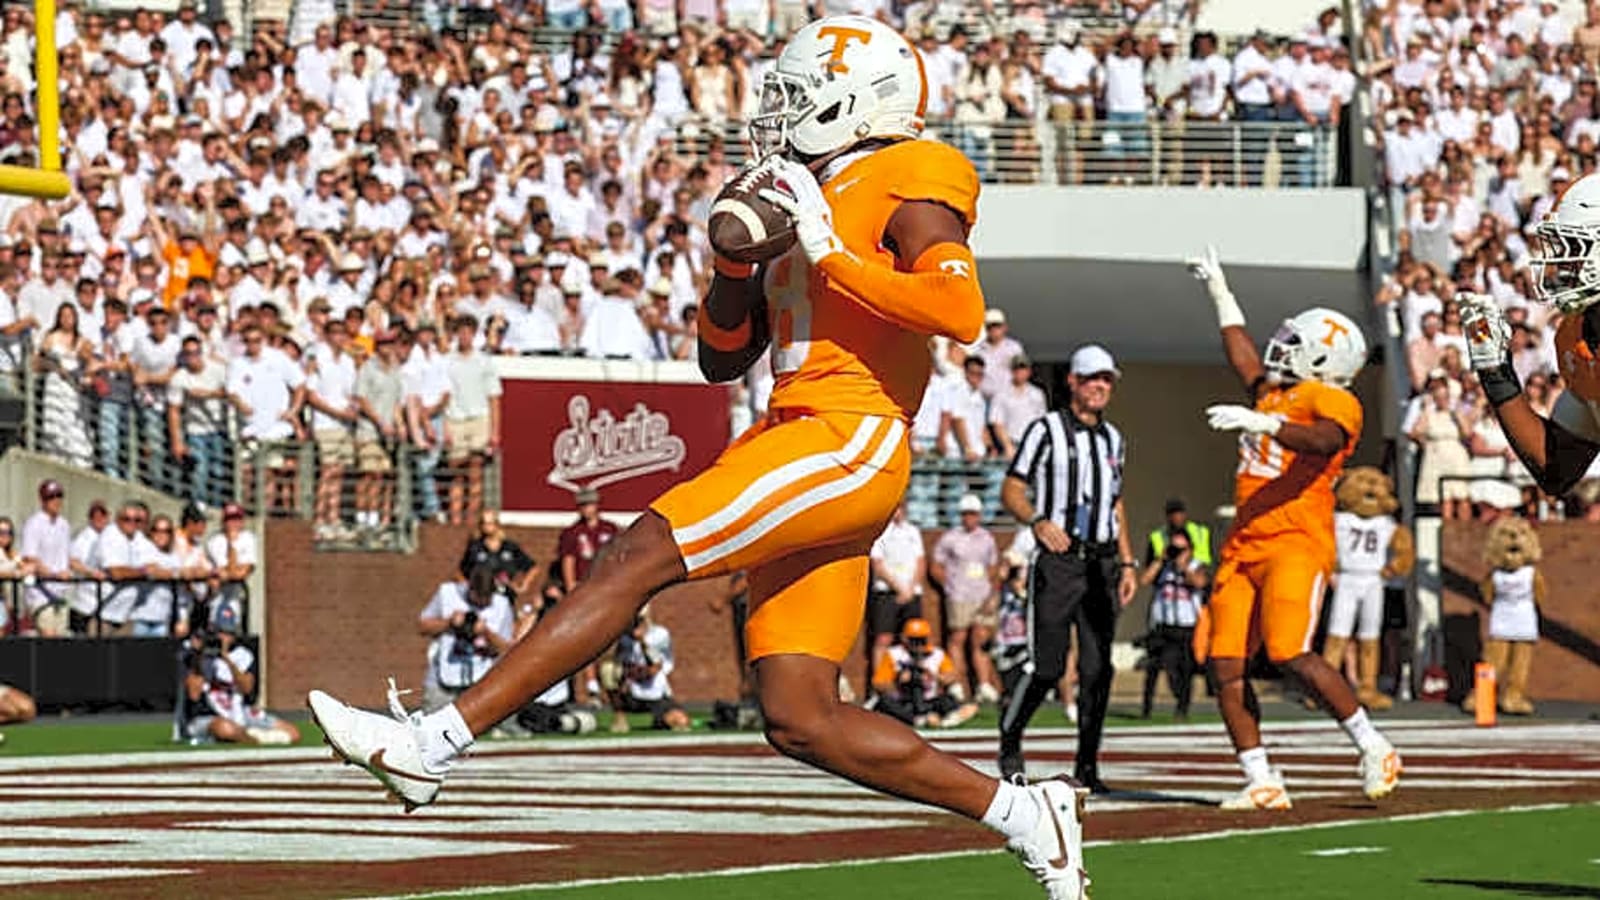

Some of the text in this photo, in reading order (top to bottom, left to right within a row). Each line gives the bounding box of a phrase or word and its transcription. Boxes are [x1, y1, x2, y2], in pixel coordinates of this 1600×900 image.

[817, 26, 872, 74] T
[764, 254, 812, 374] 8
[1322, 318, 1349, 346] T
[549, 395, 685, 488] State
